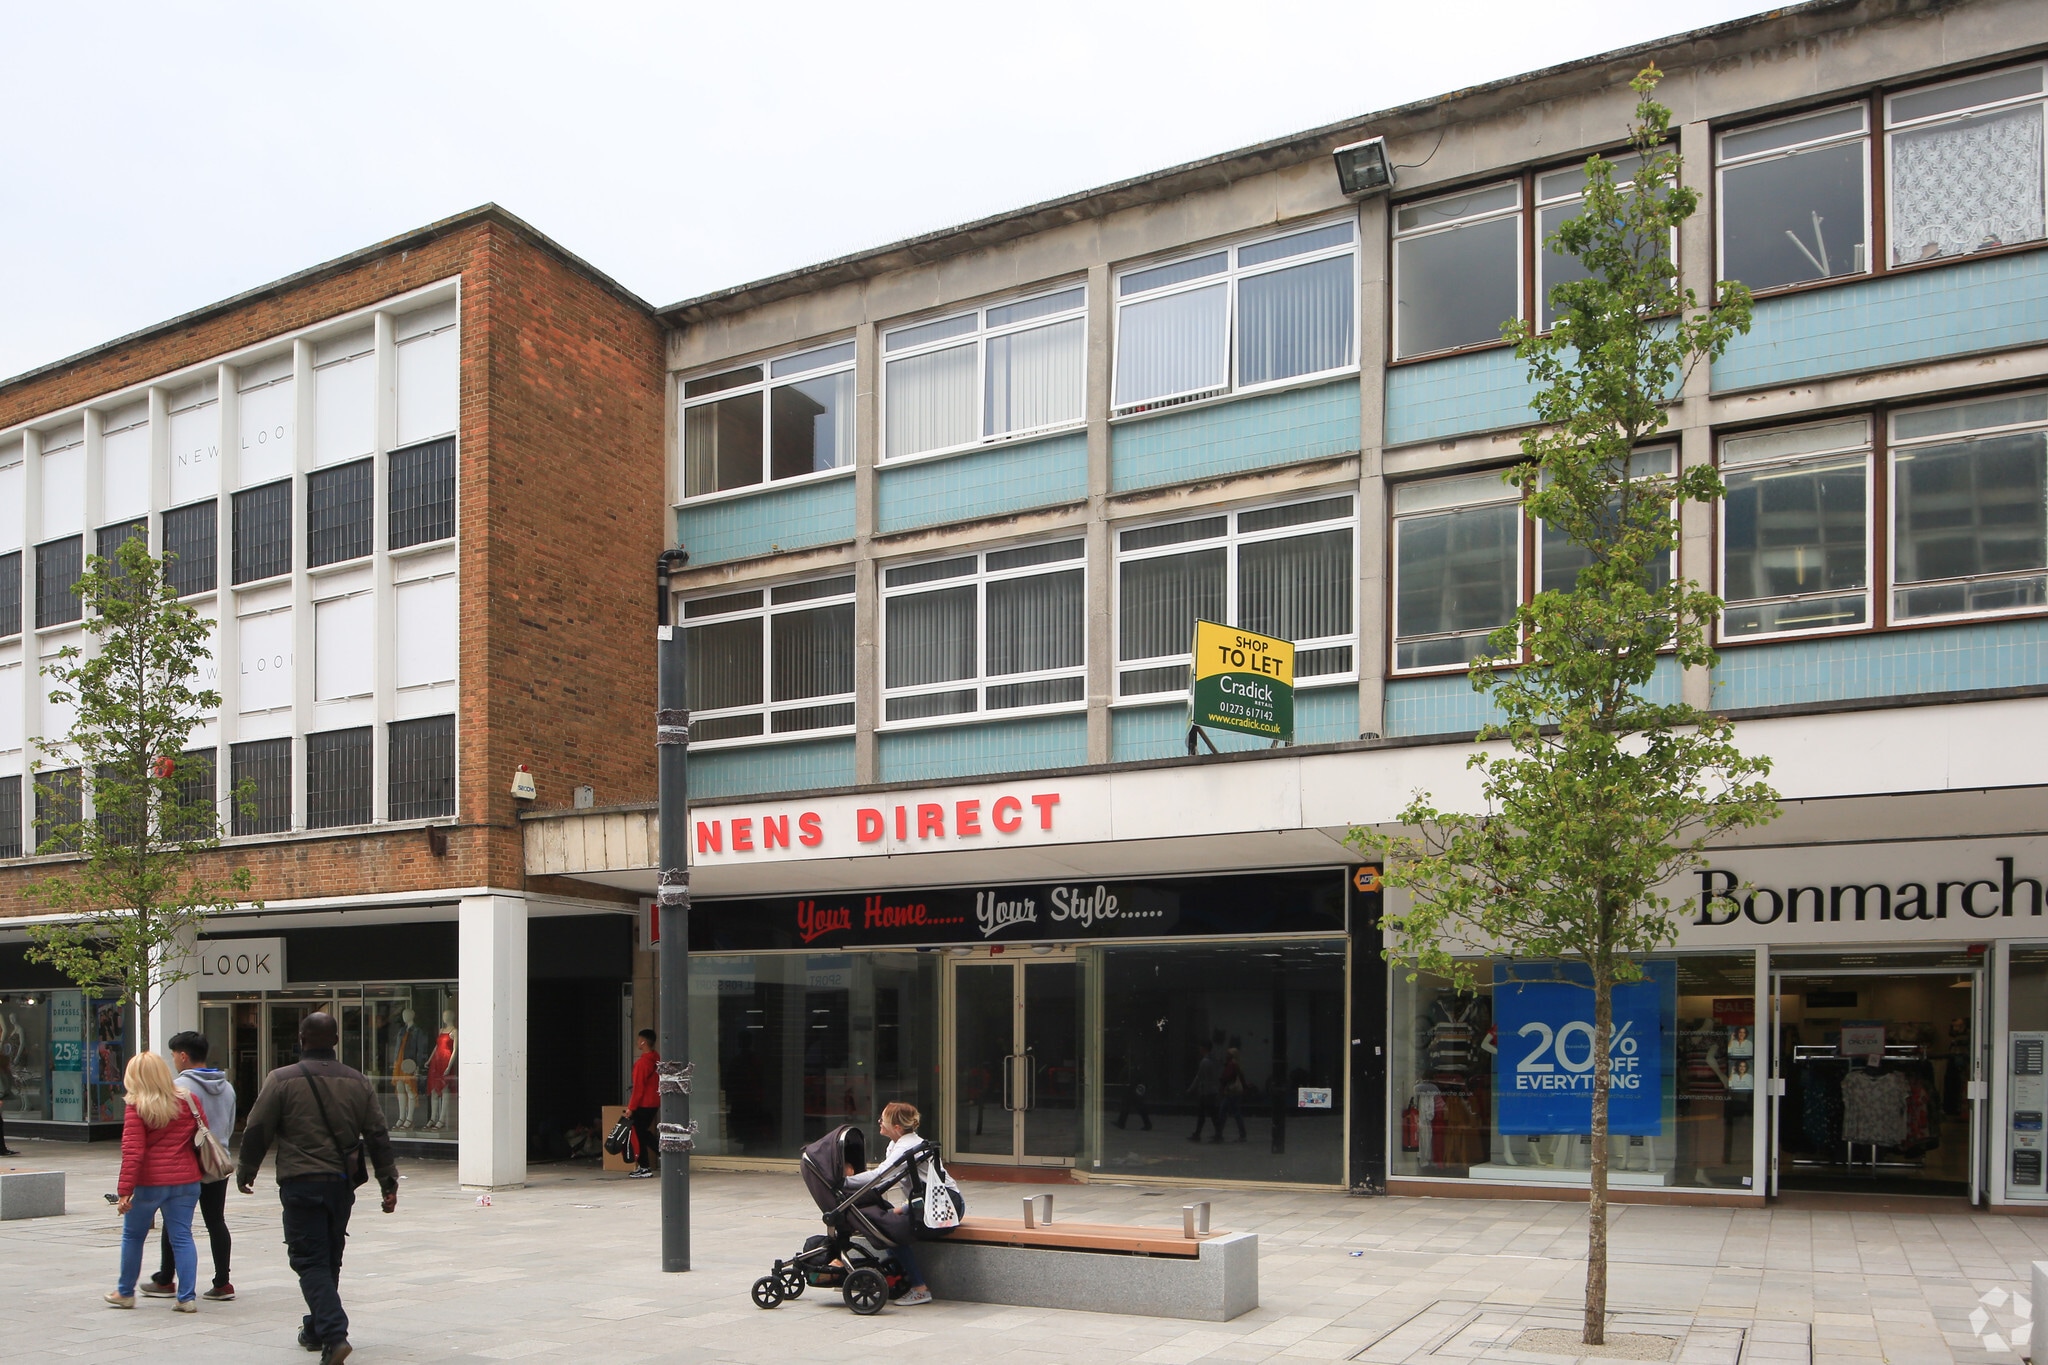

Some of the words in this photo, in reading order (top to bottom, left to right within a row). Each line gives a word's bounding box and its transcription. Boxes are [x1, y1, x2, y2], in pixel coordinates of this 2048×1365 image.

[242, 423, 294, 450] LOO
[1236, 635, 1269, 653] SHOP
[241, 652, 293, 675] LOO
[1218, 645, 1246, 668] TO
[1251, 653, 1284, 676] LET
[1220, 675, 1273, 702] Cradick
[1219, 701, 1244, 716] 01273
[1245, 707, 1273, 722] 617142
[1254, 700, 1274, 709] RETAIL
[1208, 713, 1281, 734] www.cradick.co.uk
[696, 812, 824, 854] NENS
[857, 793, 1061, 843] DIRECT
[1693, 856, 2048, 927] Bonmarch
[797, 900, 852, 944] Your
[976, 891, 1038, 938] Your
[202, 953, 271, 976] LOOK
[55, 1043, 79, 1060] 25%
[1516, 1021, 1638, 1073] 20%
[55, 1097, 80, 1105] MONDAY
